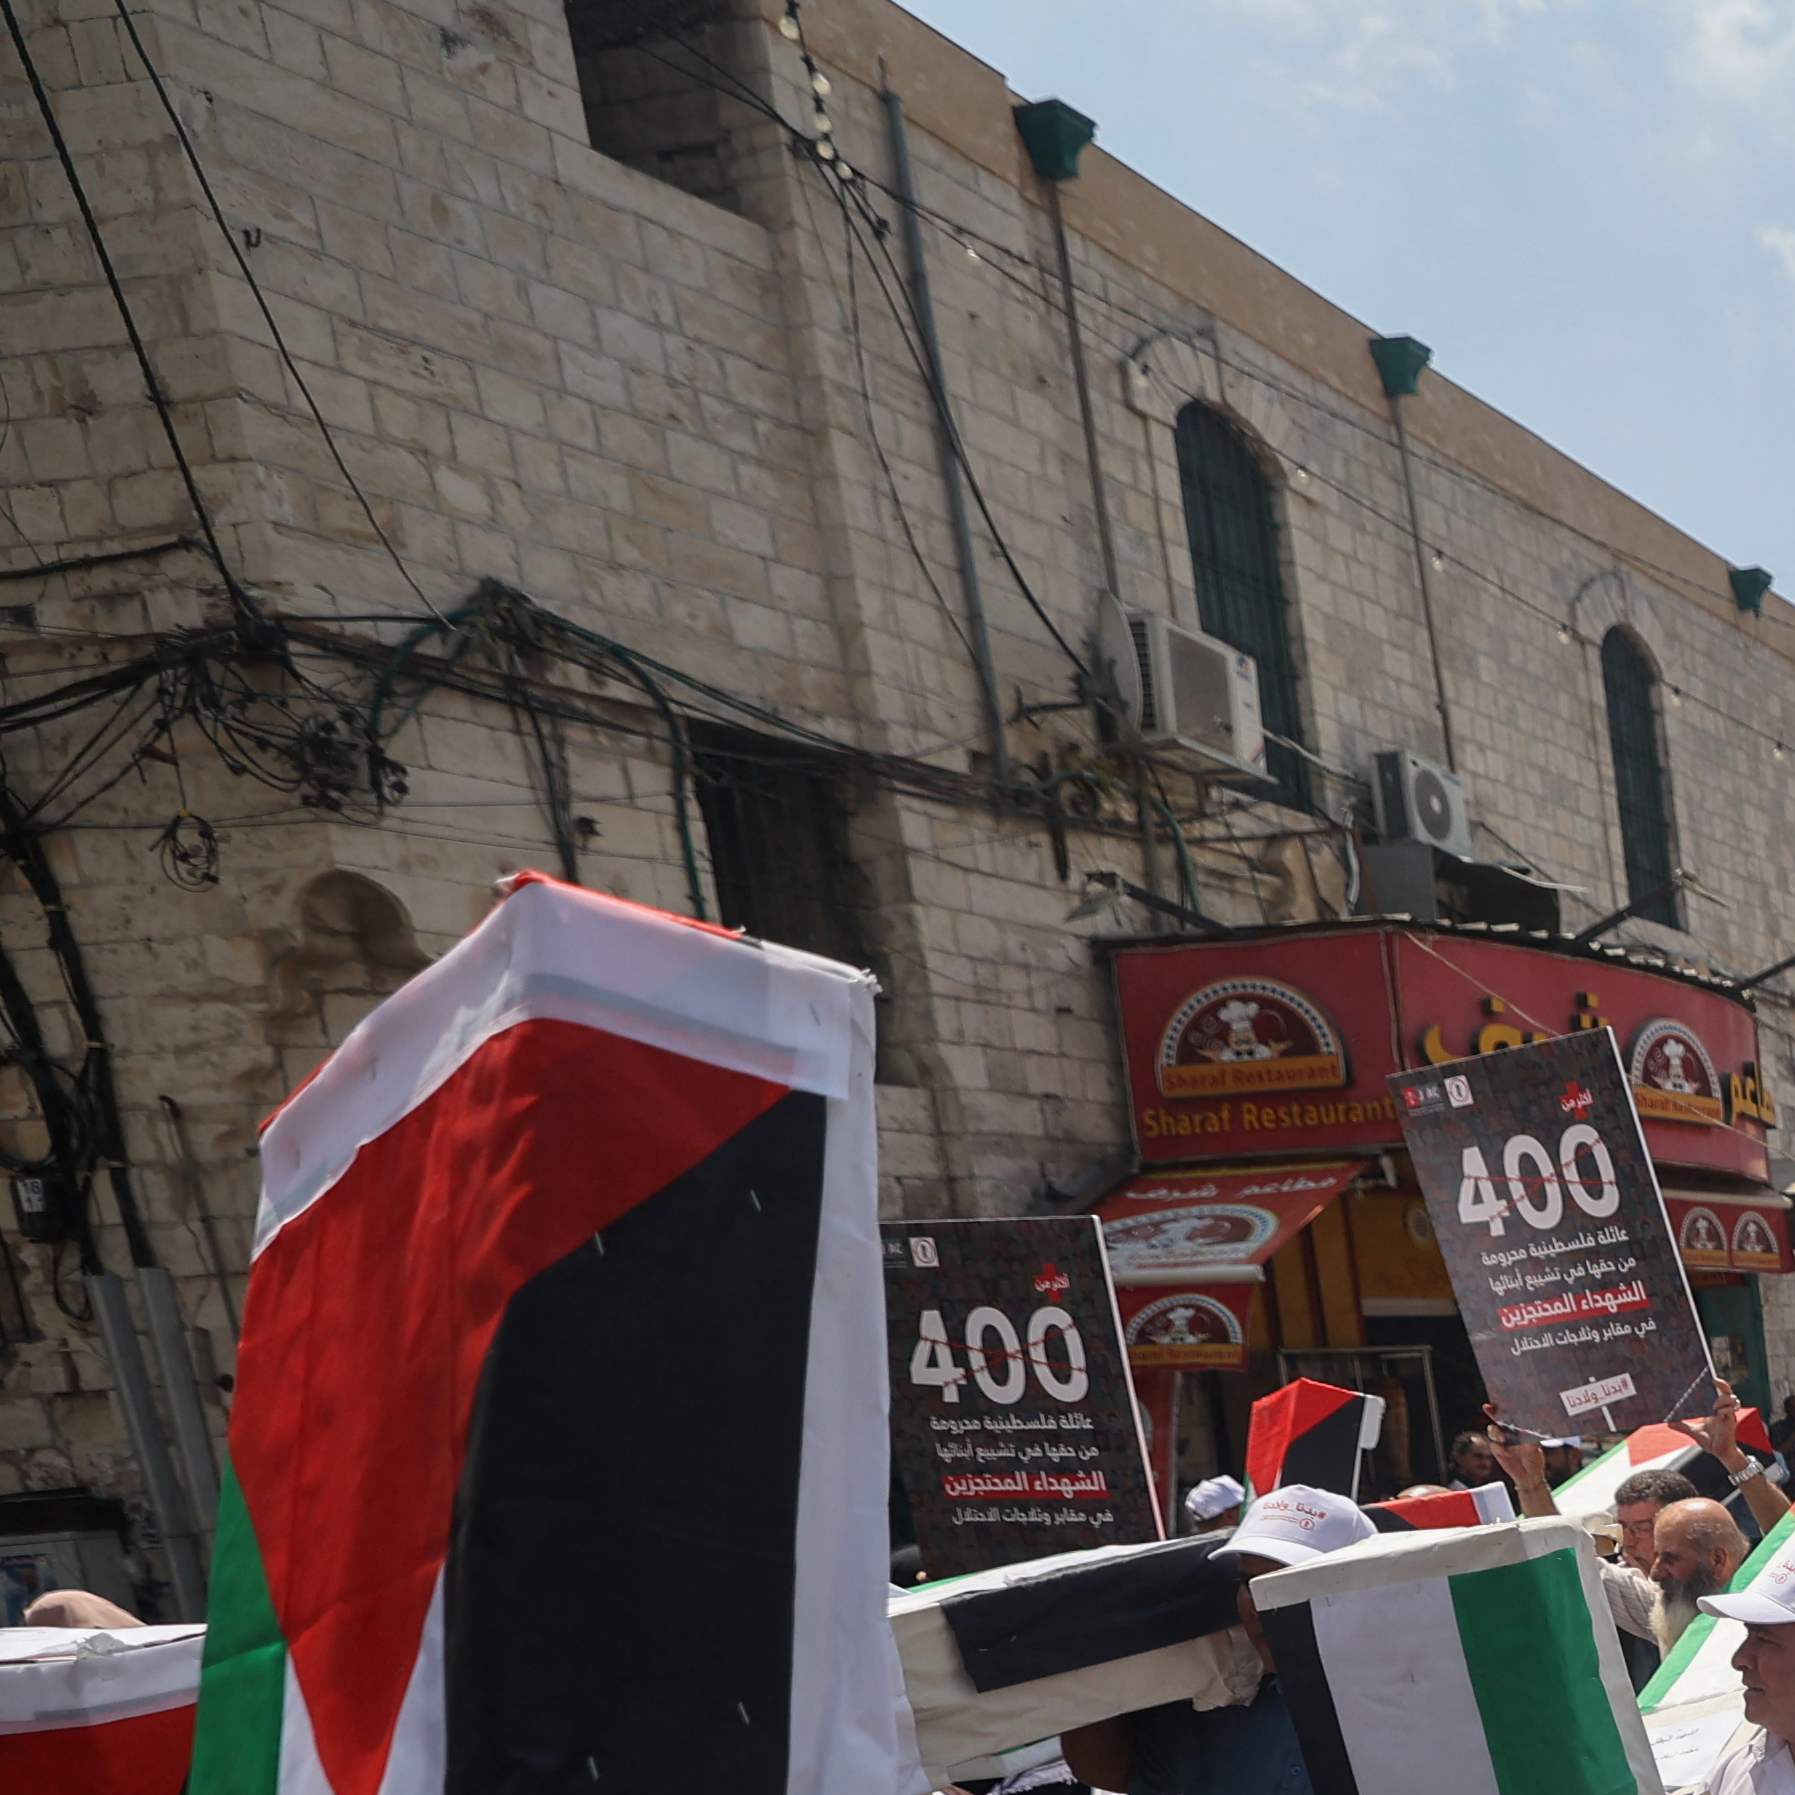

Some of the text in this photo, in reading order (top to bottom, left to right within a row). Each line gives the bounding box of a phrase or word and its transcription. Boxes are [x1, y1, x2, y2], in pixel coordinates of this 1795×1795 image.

[1144, 1105, 1231, 1138] Sharaf
[1242, 1096, 1397, 1131] Restaurant
[1457, 1123, 1621, 1238] 400
[1481, 1225, 1630, 1268] عائلة فلسطينية محرومة
[1563, 1263, 1585, 1285] في
[1586, 1258, 1615, 1278] حقها
[1617, 1256, 1637, 1272] من
[1500, 1279, 1647, 1329] الشهداء المحتجزين
[1511, 1317, 1657, 1356] في مقابر وثلاجات الاحتلال
[910, 1305, 1090, 1405] 400
[930, 1412, 1094, 1435] عائلة فلسطينية محرومة
[1018, 1445, 1044, 1464] في
[1044, 1441, 1077, 1463] حقها
[1078, 1445, 1100, 1460] من
[945, 1470, 1107, 1499] الشهداء المحتجزين
[1002, 1507, 1052, 1526] وثلاجات
[1054, 1508, 1087, 1526] مقابر
[1089, 1508, 1115, 1529] في
